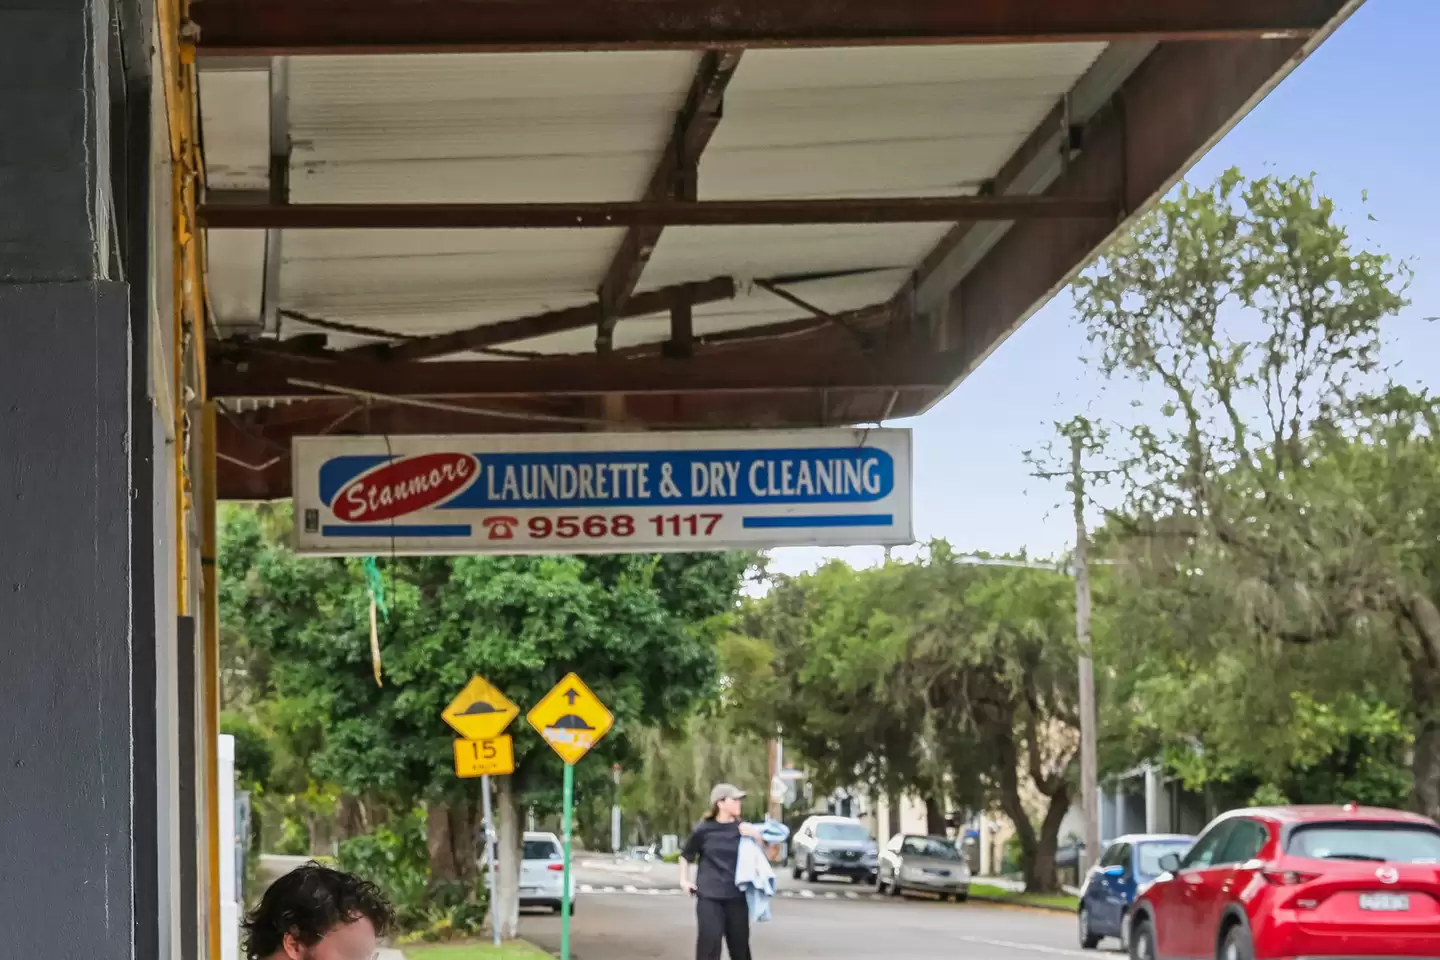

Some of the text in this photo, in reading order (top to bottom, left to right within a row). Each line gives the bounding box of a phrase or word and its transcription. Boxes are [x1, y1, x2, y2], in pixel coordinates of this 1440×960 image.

[346, 457, 881, 519] Stanmore LAUNDRETTE & DRY CLEANING
[527, 513, 724, 540] 9568 1117
[471, 740, 497, 761] 15
